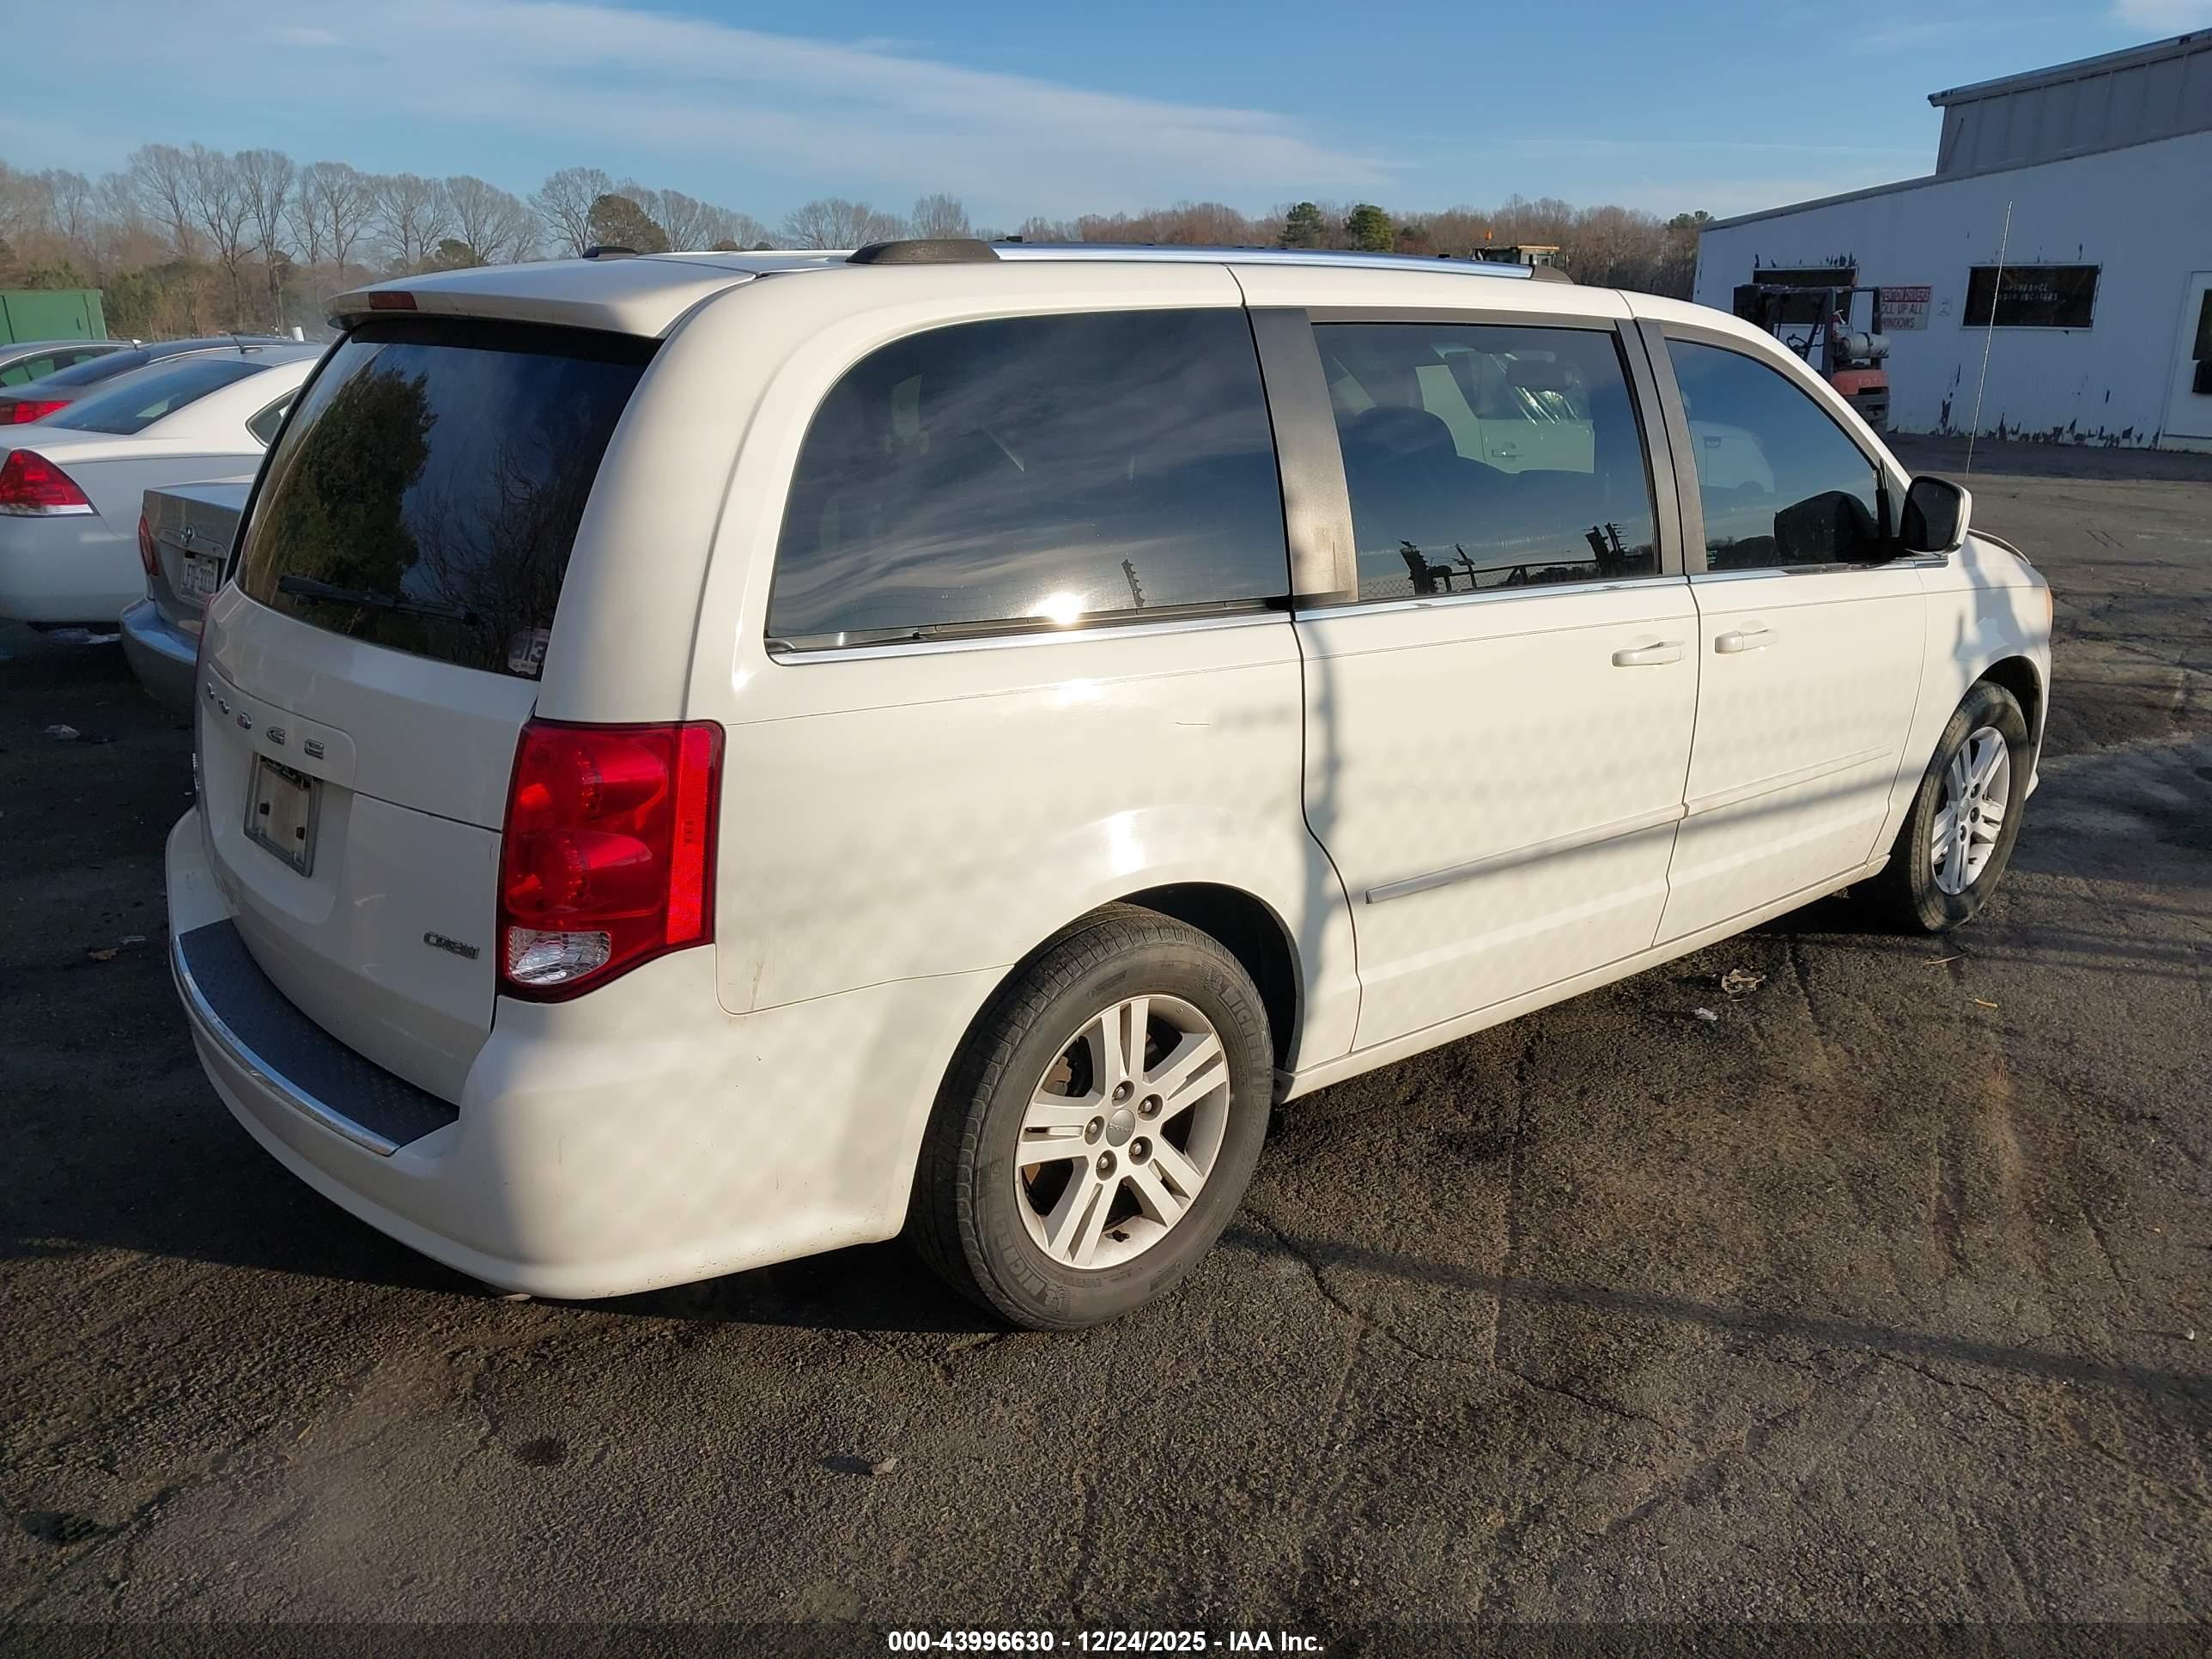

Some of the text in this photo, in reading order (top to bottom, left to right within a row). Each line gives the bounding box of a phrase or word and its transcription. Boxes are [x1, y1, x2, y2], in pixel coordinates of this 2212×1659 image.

[1881, 288, 1929, 301] TENTION DRIVERS
[1881, 303, 1923, 314] OLL UP ALL
